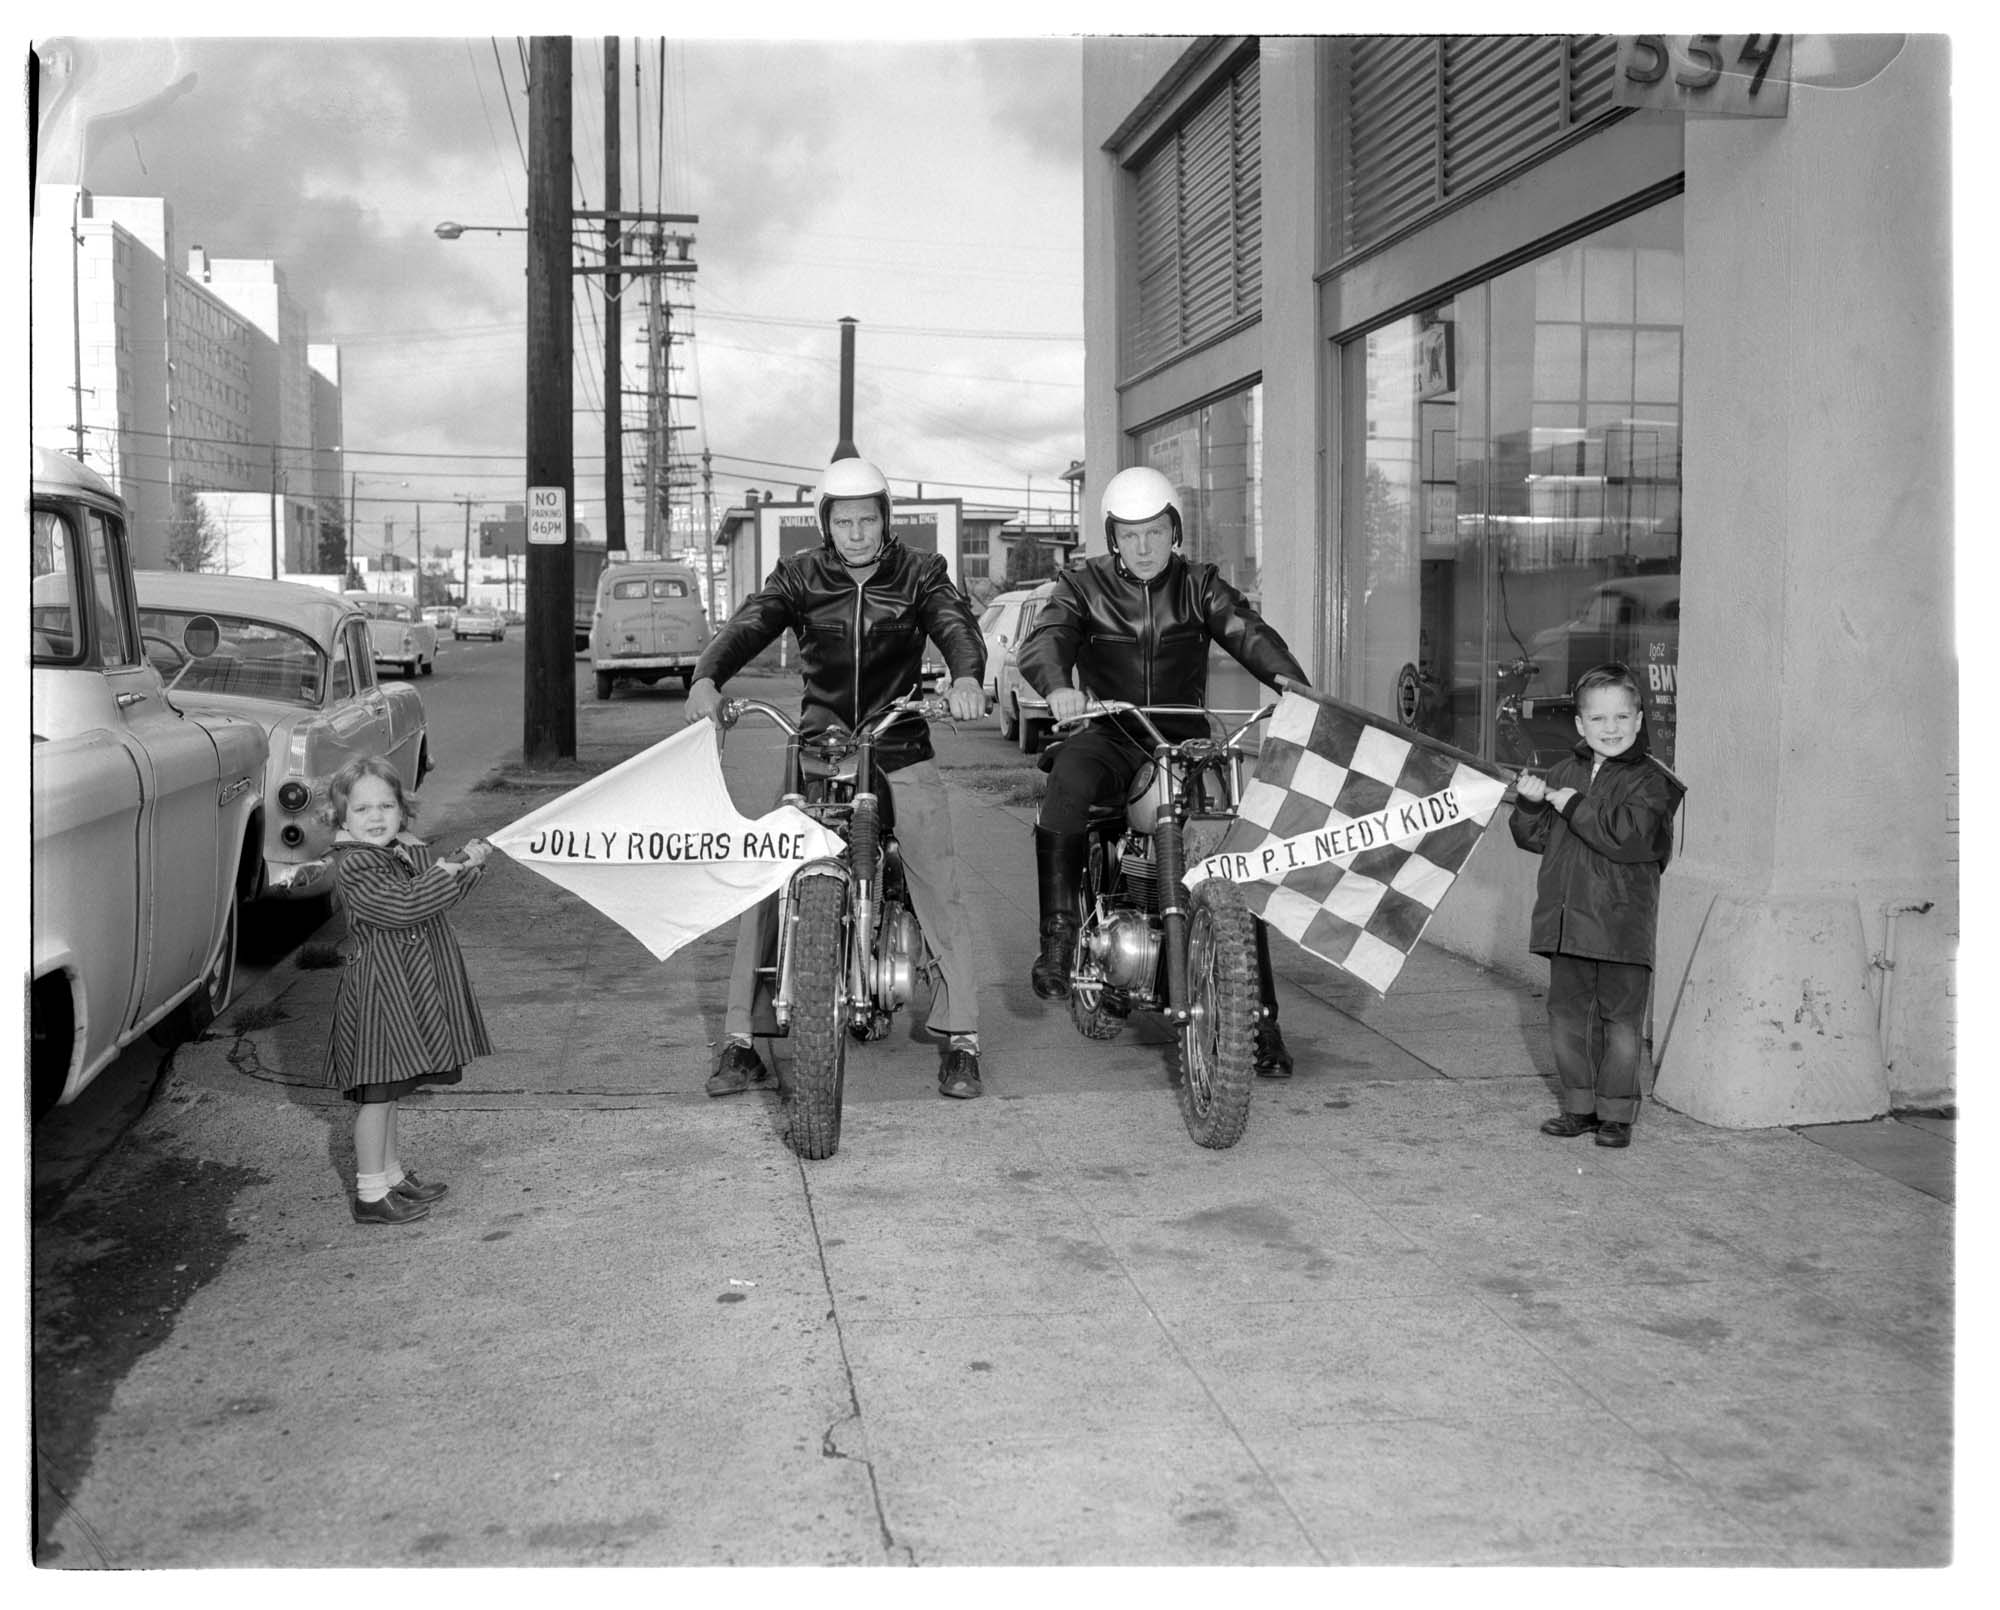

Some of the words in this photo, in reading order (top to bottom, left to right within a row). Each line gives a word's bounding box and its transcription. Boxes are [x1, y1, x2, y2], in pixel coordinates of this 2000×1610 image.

[535, 492, 557, 506] NO
[1649, 642, 1665, 661] 1962
[530, 829, 617, 859] JOLLY
[628, 831, 732, 861] ROGERS
[743, 832, 806, 860] RACE
[1205, 852, 1250, 880] FOR
[1315, 812, 1390, 861] NEEDY
[1400, 790, 1459, 835] KIDS
